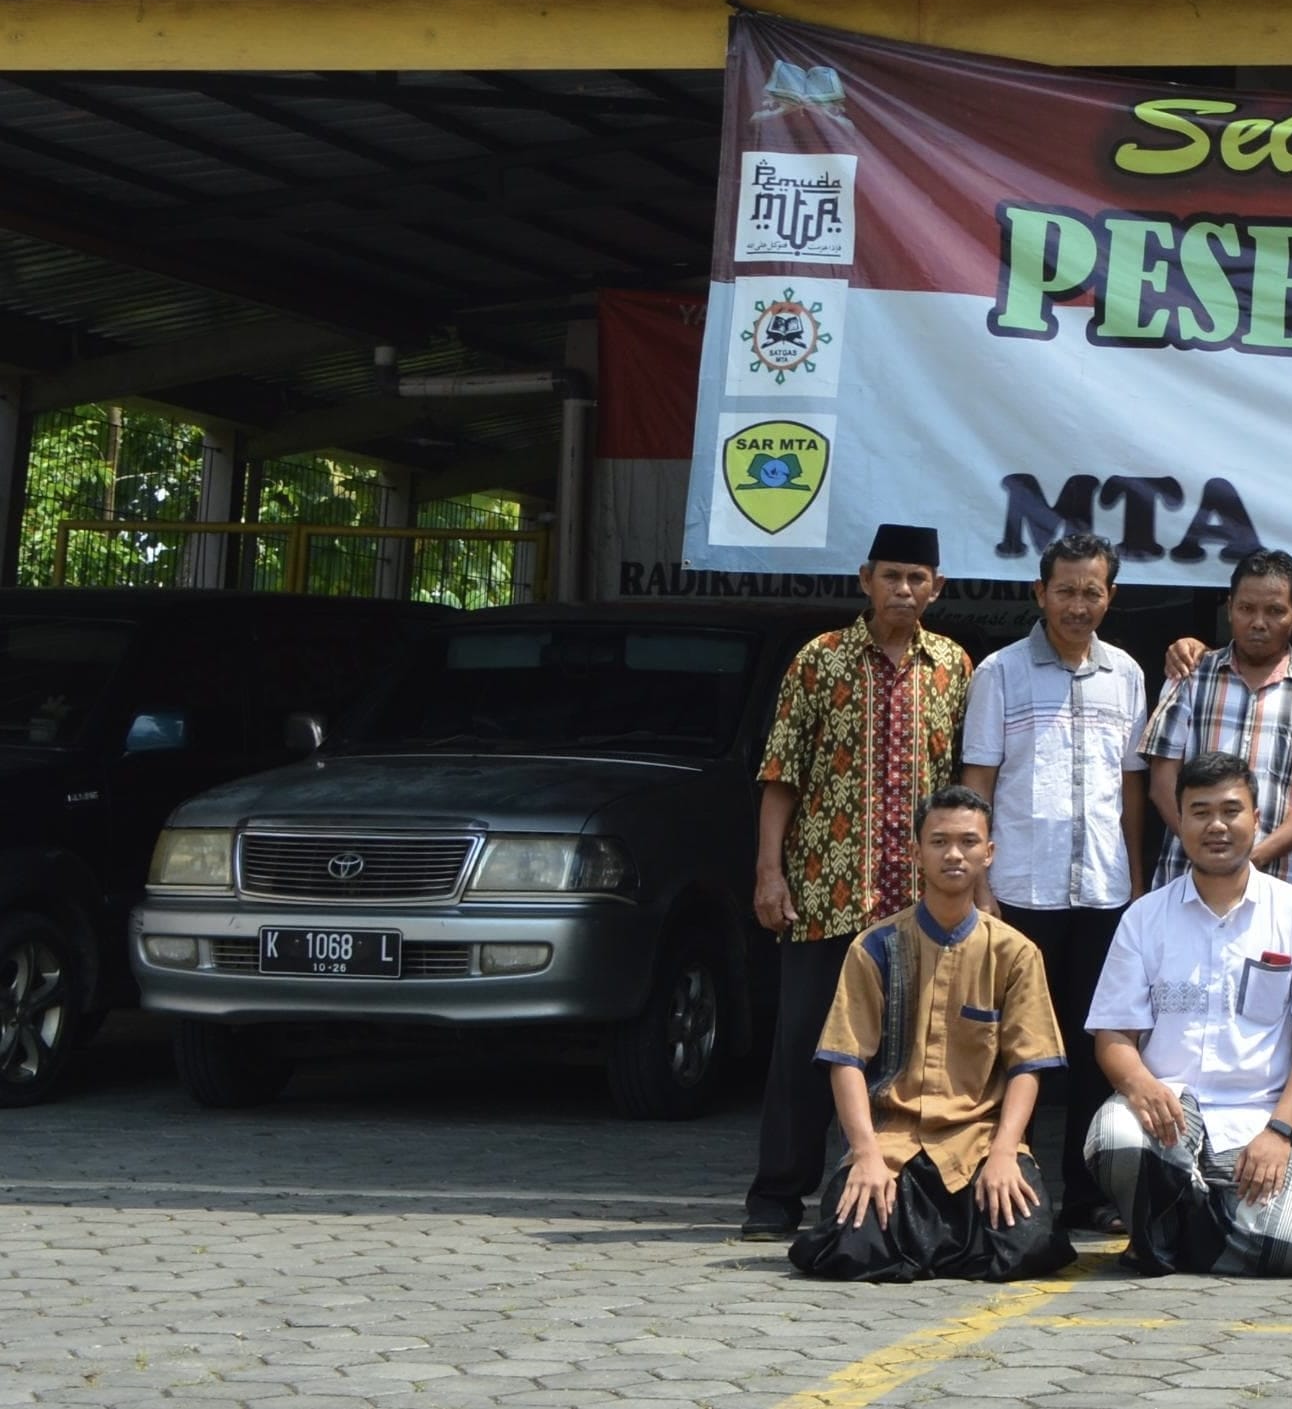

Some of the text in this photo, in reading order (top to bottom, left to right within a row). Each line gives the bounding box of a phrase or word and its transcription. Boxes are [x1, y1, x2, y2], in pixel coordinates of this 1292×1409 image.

[768, 349, 797, 357] SATGAS
[736, 438, 818, 451] SAR MTA
[994, 473, 1276, 567] MTA
[267, 931, 393, 962] K 1068 L
